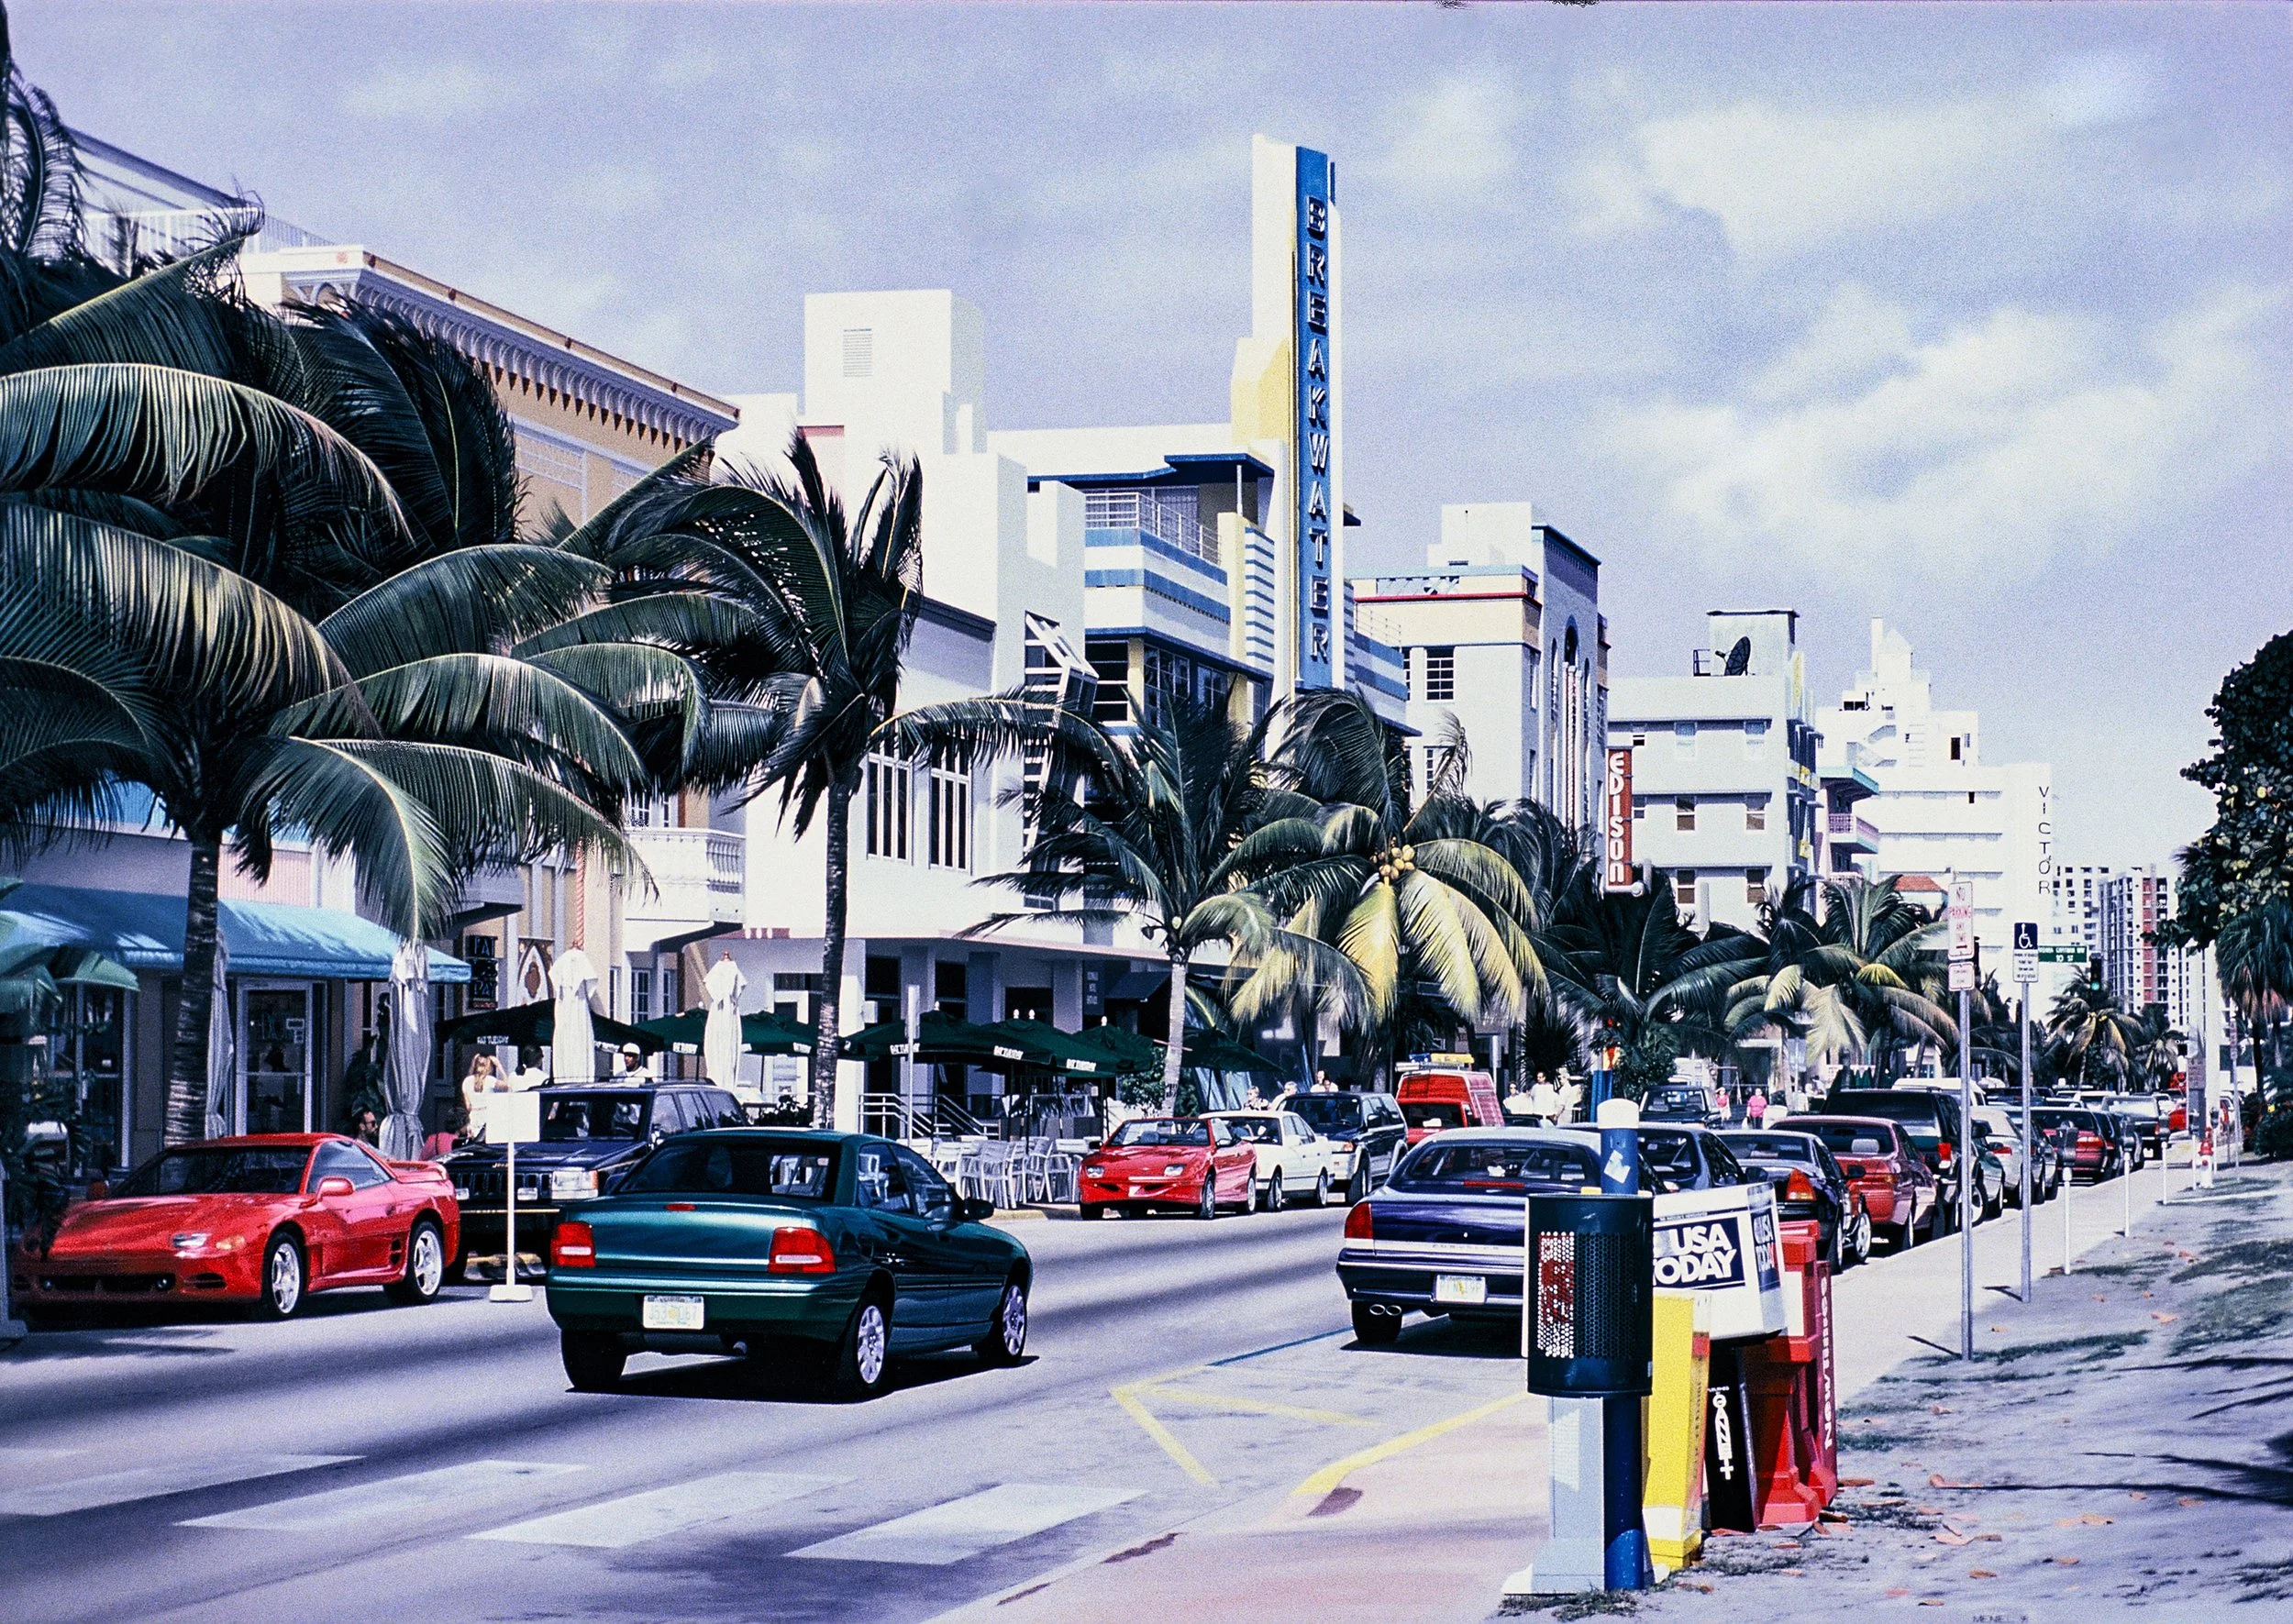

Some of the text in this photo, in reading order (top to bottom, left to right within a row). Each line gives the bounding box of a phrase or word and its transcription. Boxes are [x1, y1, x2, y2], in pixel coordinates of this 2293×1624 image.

[1305, 195, 1329, 663] BREAKWATER
[1609, 751, 1625, 883] EDISON
[2038, 786, 2051, 895] VICTOR
[2055, 954, 2065, 962] 10
[1669, 1222, 1734, 1255] USA
